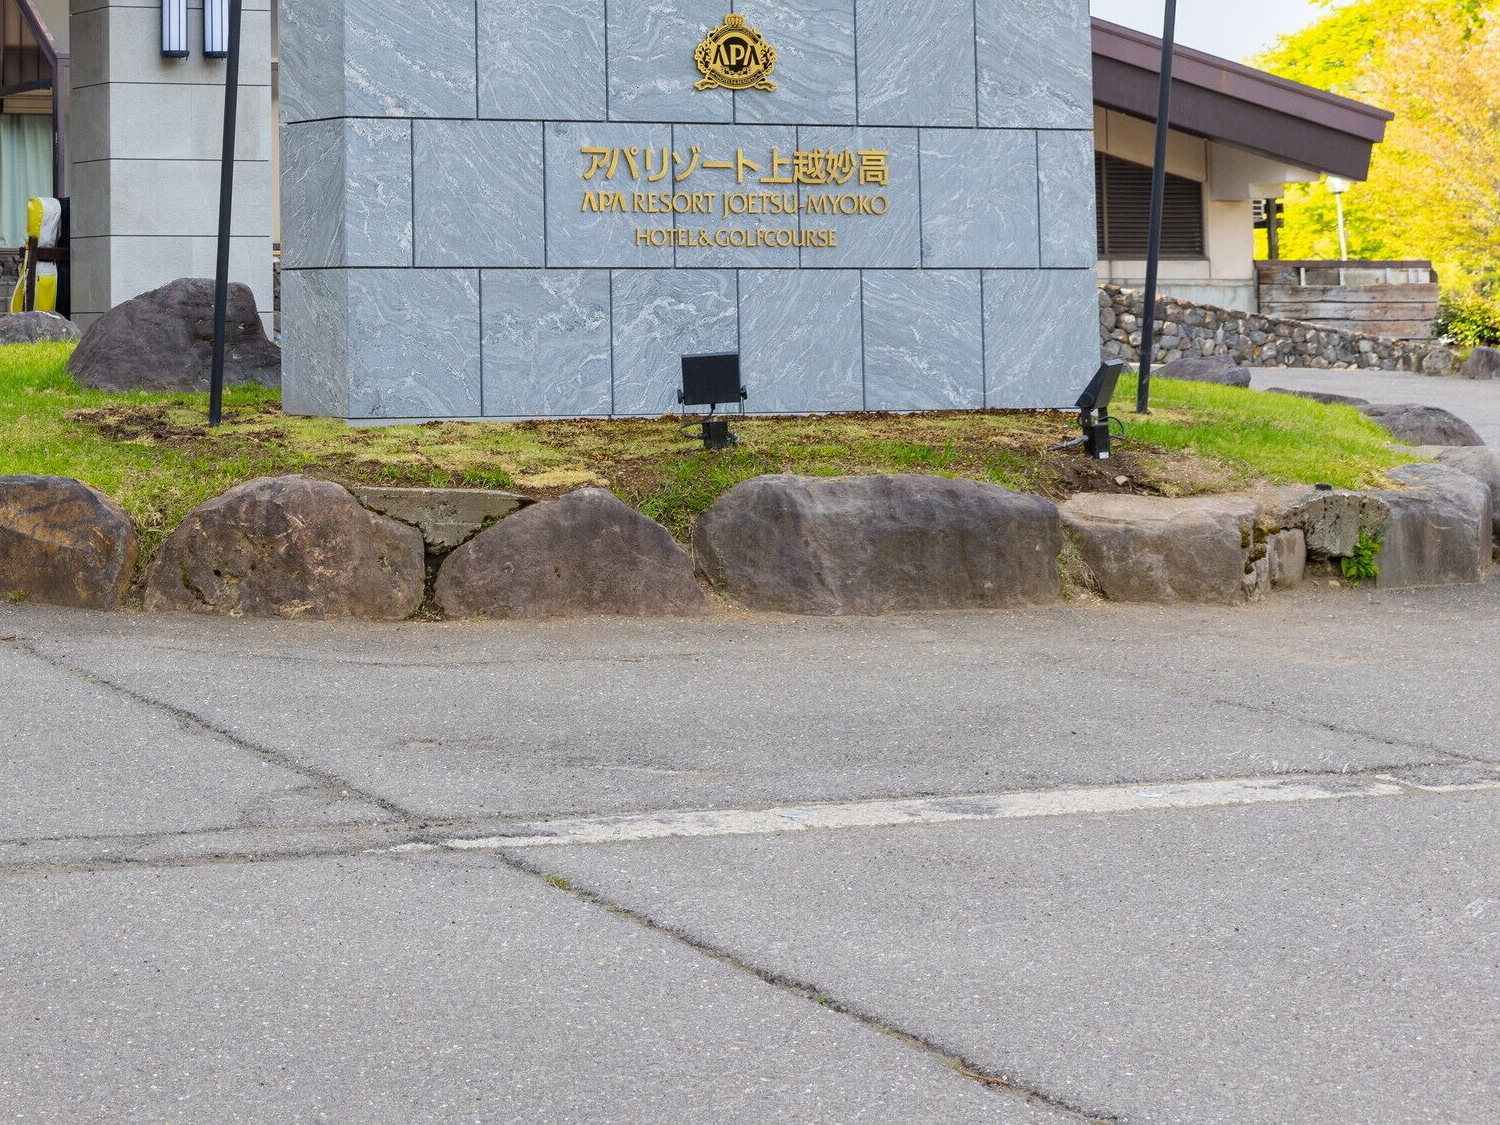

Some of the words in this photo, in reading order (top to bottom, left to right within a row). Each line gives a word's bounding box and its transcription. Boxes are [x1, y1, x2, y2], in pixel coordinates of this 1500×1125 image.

[712, 44, 760, 66] APA
[580, 145, 890, 186] アパリゾート上越妙高
[581, 190, 628, 213] APA
[632, 191, 716, 214] RESORT
[721, 192, 889, 219] JOETSU-MYOKO
